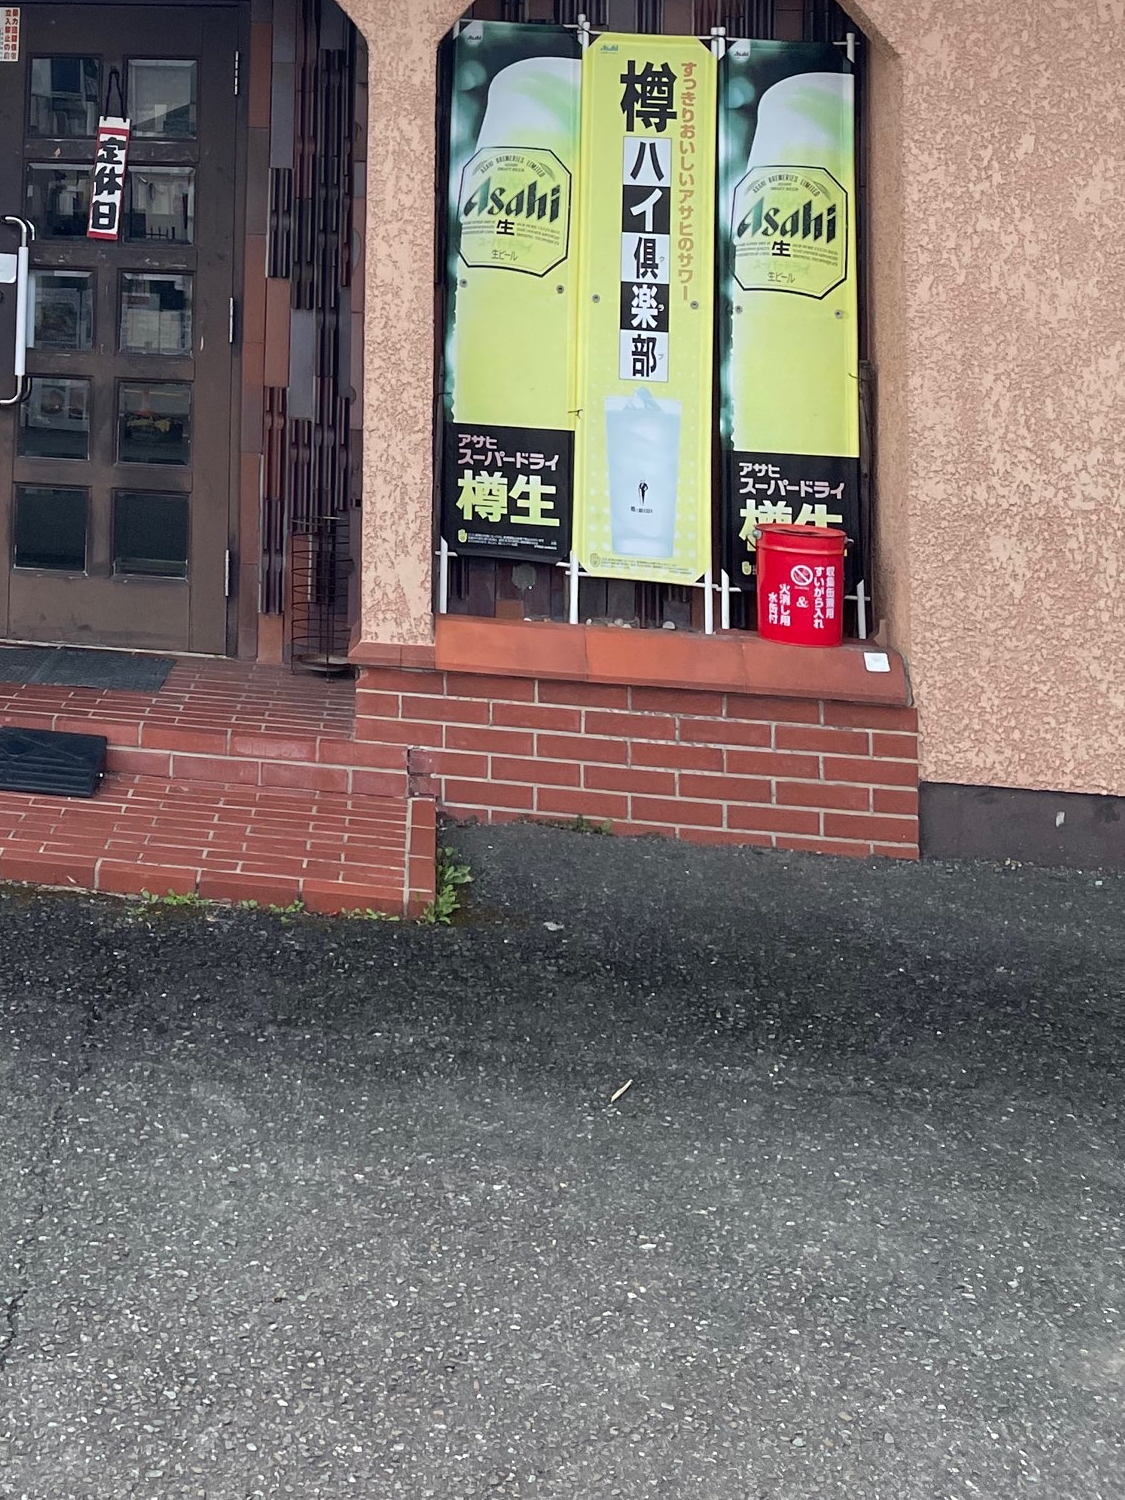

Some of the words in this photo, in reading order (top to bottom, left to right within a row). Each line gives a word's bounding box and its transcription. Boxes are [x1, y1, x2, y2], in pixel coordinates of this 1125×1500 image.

[92, 136, 127, 231] 定休日
[678, 62, 697, 300] すっきりおいしいアサヒのサワー
[463, 176, 561, 223] Asahi
[496, 219, 515, 236] 生
[737, 196, 837, 244] Asahi
[491, 249, 518, 261] 生ビール
[771, 240, 791, 257] 生
[767, 271, 795, 283] 生ビール
[458, 433, 498, 449] アサヒ
[457, 448, 559, 471] スーパードライ
[738, 462, 781, 478] アサヒ
[455, 469, 560, 527] 樽生
[739, 477, 845, 500] スーパードライ
[796, 596, 809, 608] &
[813, 566, 825, 629] すいがら入れ
